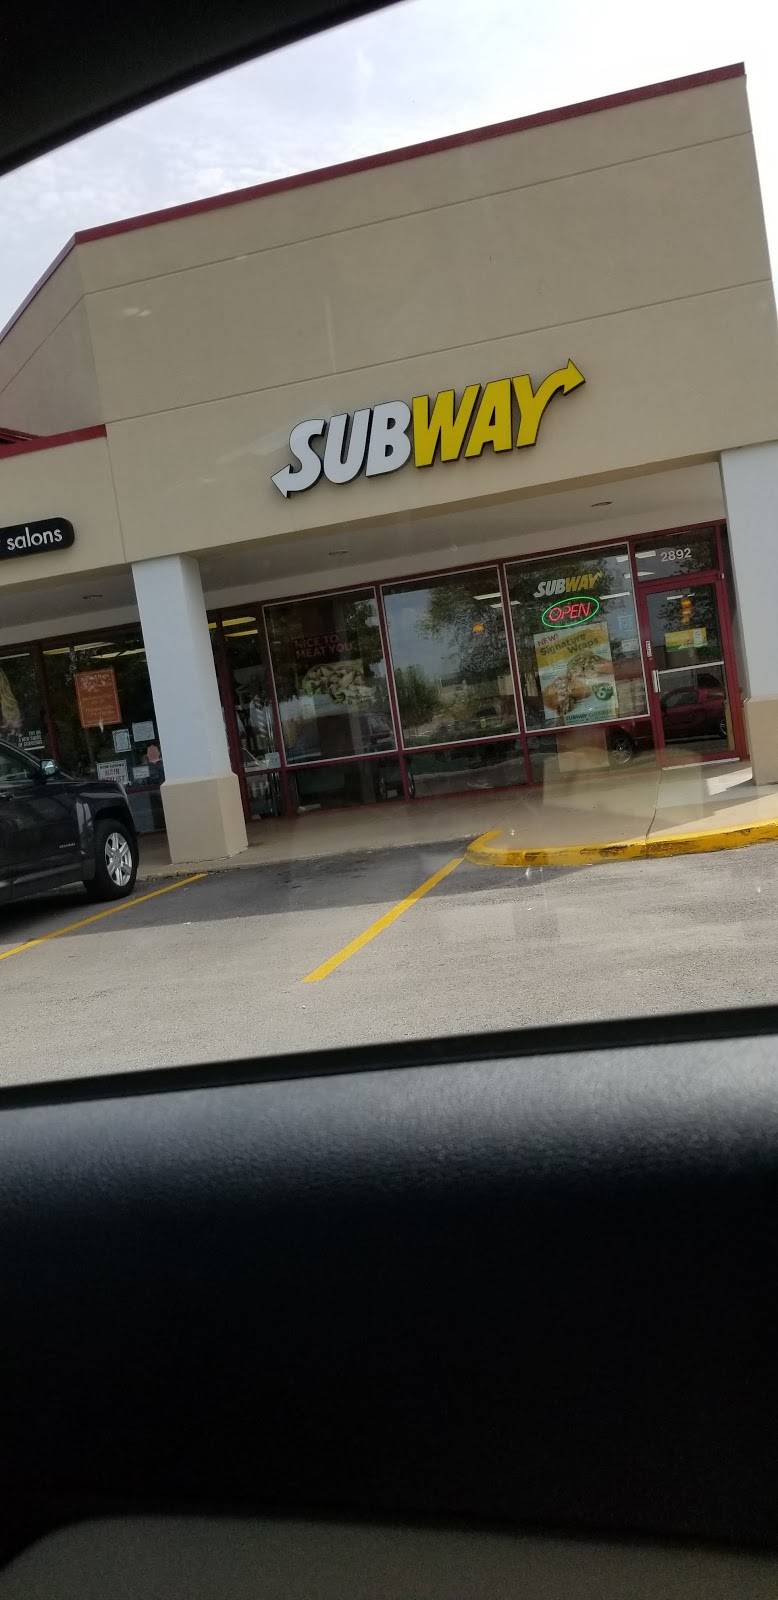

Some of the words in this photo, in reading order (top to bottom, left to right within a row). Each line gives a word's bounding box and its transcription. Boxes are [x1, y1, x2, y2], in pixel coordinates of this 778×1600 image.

[271, 358, 586, 498] SUBWAY
[6, 526, 63, 551] salons
[660, 547, 692, 562] 2892
[533, 571, 604, 598] SUBWAY
[548, 601, 591, 622] OPEN
